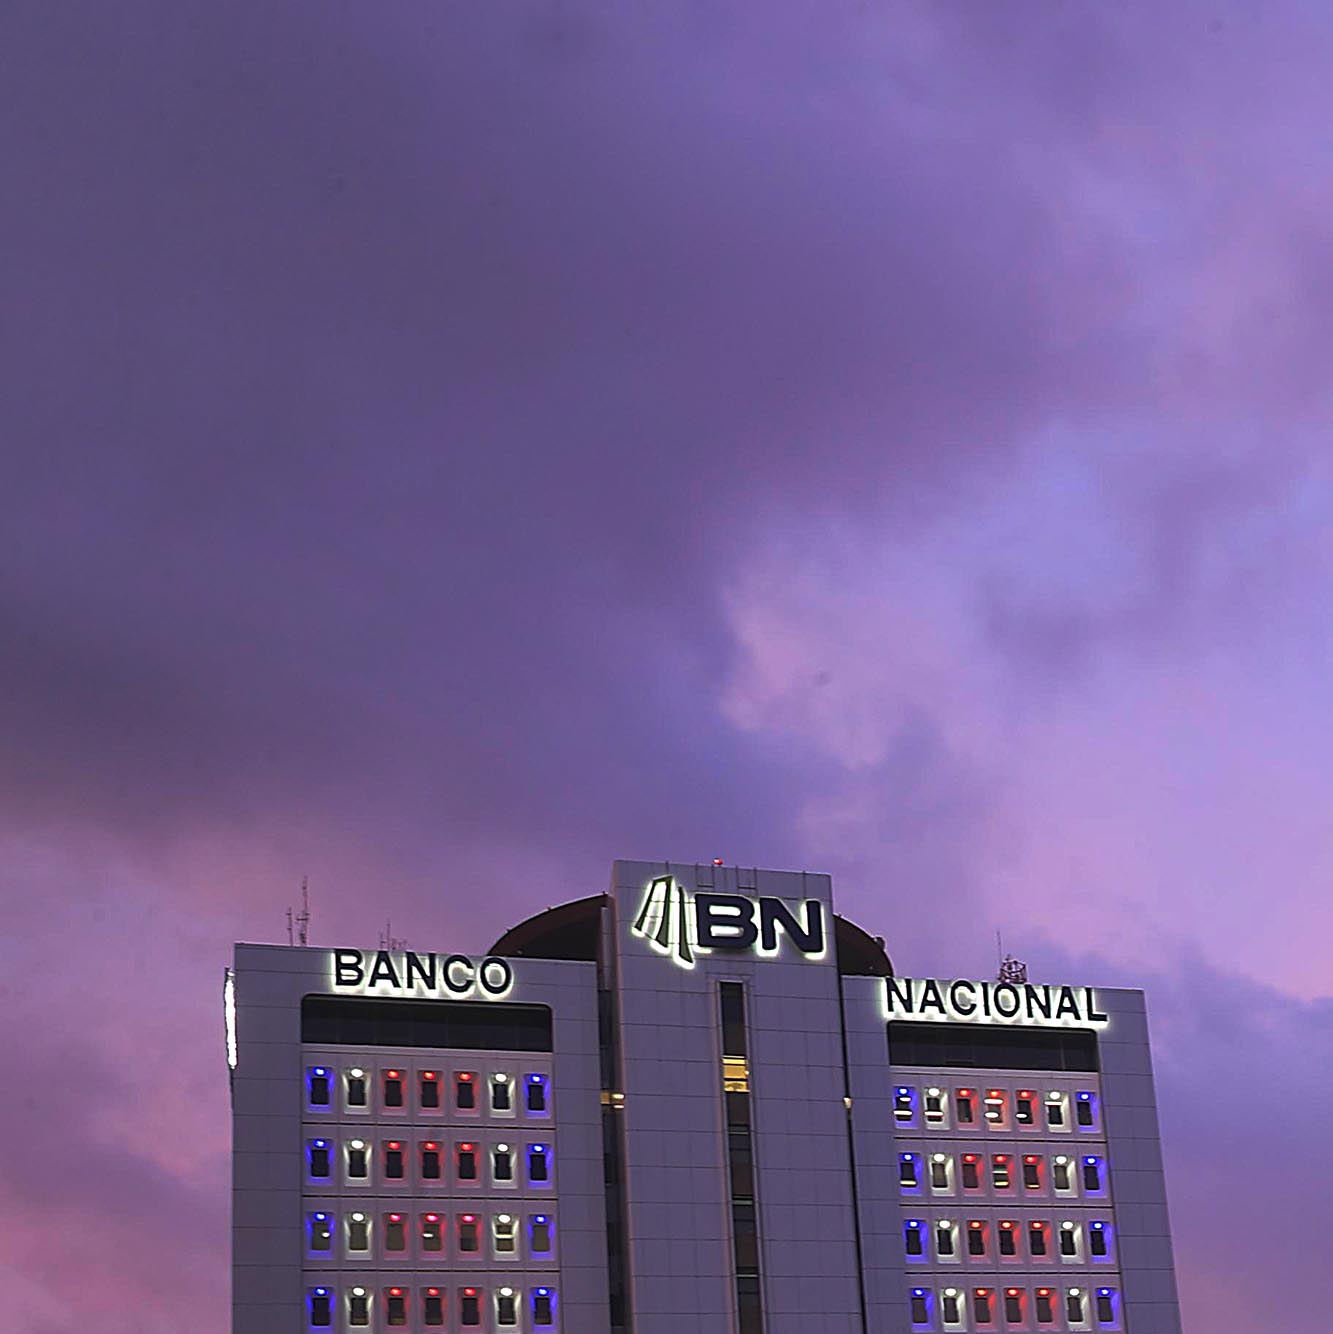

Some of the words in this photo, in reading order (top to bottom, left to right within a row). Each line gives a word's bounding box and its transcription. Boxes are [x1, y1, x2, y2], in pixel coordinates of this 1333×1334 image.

[695, 893, 824, 953] BN
[333, 947, 512, 994] BANCO
[885, 976, 1109, 1022] NACIONAL
